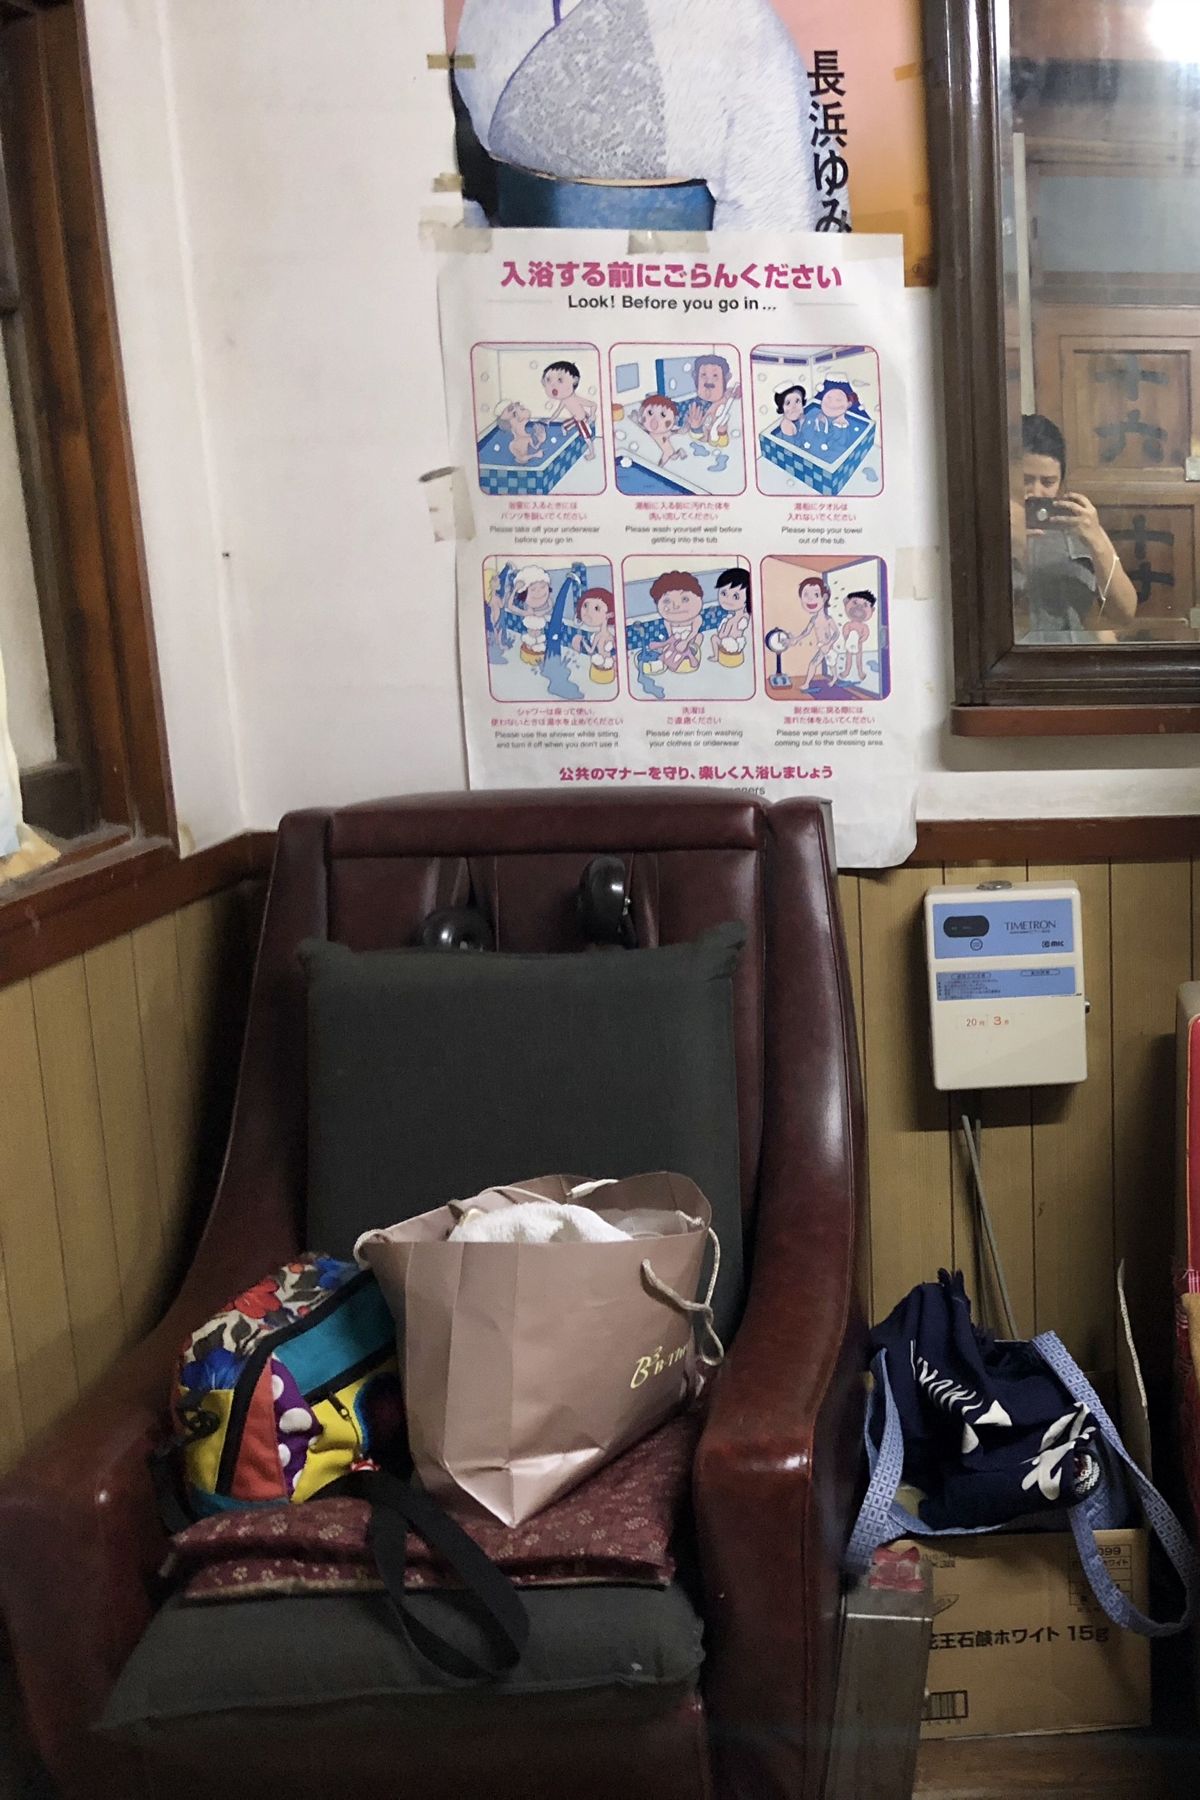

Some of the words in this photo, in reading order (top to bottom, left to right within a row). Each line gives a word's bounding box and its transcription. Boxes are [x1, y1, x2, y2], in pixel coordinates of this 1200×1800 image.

[500, 261, 842, 289] 入浴する前にごらんください
[568, 296, 615, 309] Look!
[622, 296, 677, 310] Before
[683, 298, 713, 313] you
[719, 298, 739, 313] go
[744, 297, 758, 311] in
[782, 526, 806, 534] Please
[715, 730, 743, 738] washing
[559, 766, 833, 780] 公共のマナーを守り、楽しく入浴しましょう
[1004, 920, 1056, 932] TIMETRON
